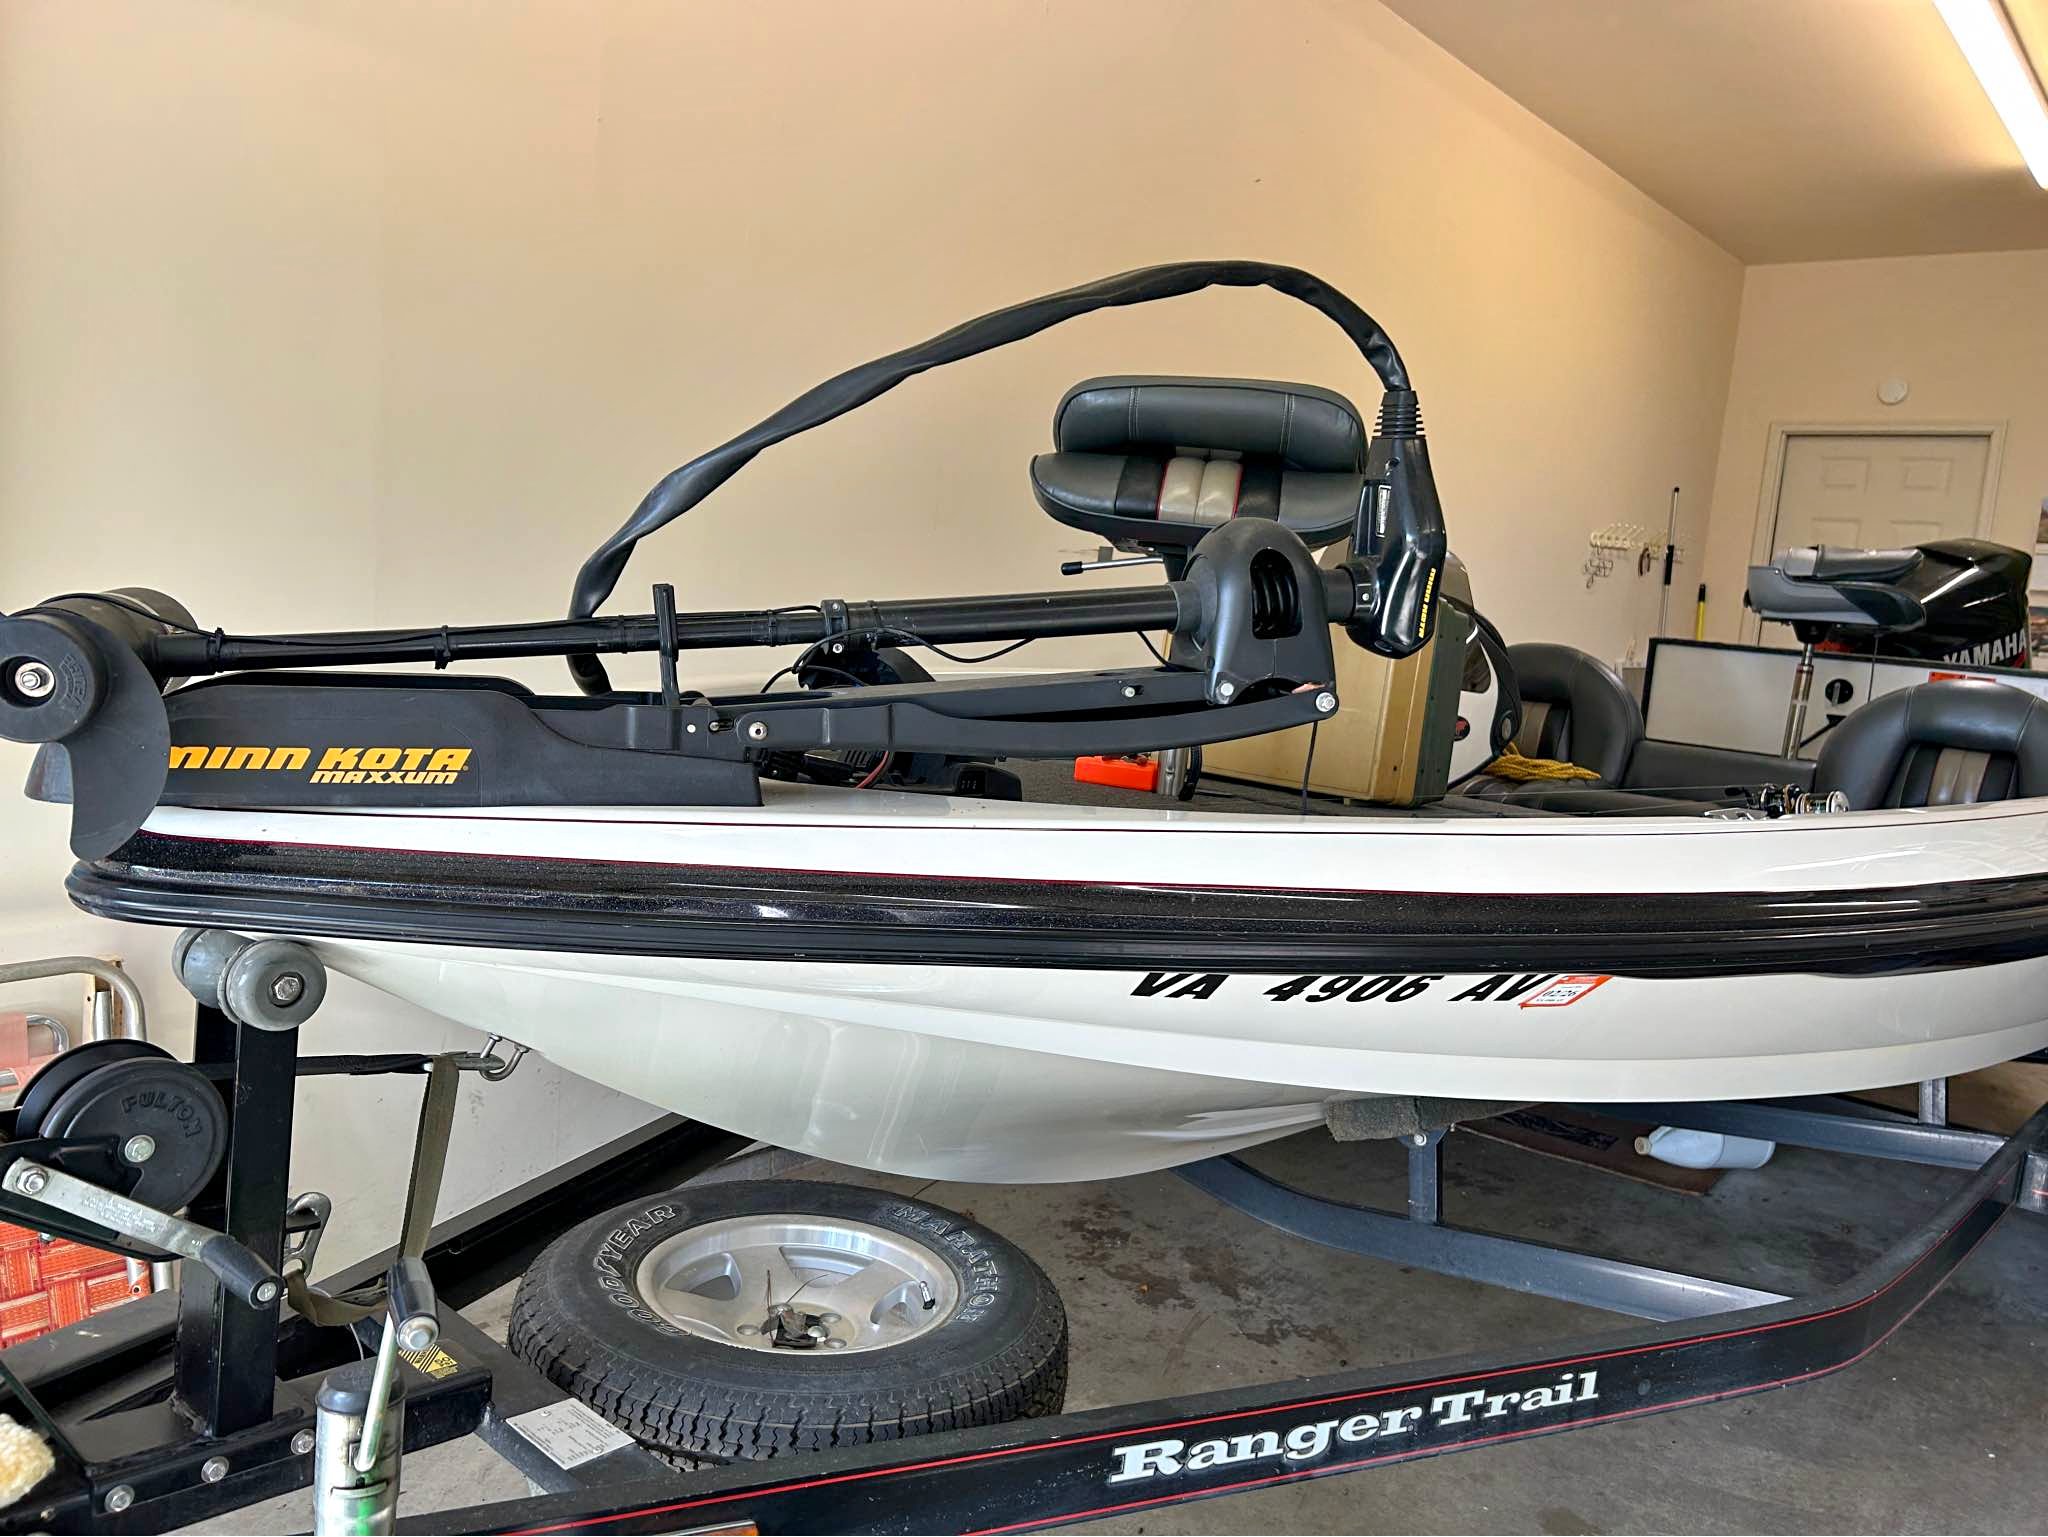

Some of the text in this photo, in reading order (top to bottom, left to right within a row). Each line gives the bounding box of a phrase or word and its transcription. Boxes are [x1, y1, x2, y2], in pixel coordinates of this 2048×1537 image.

[309, 770, 458, 784] MAXXUM
[317, 747, 472, 771] KOTA
[1130, 972, 1560, 1002] VA 4906 AV
[121, 1091, 202, 1137] FULTON
[593, 1203, 692, 1336] GOODYEAR
[894, 1205, 999, 1322] MARATHON
[1108, 1370, 1599, 1483] Ranger Trail
